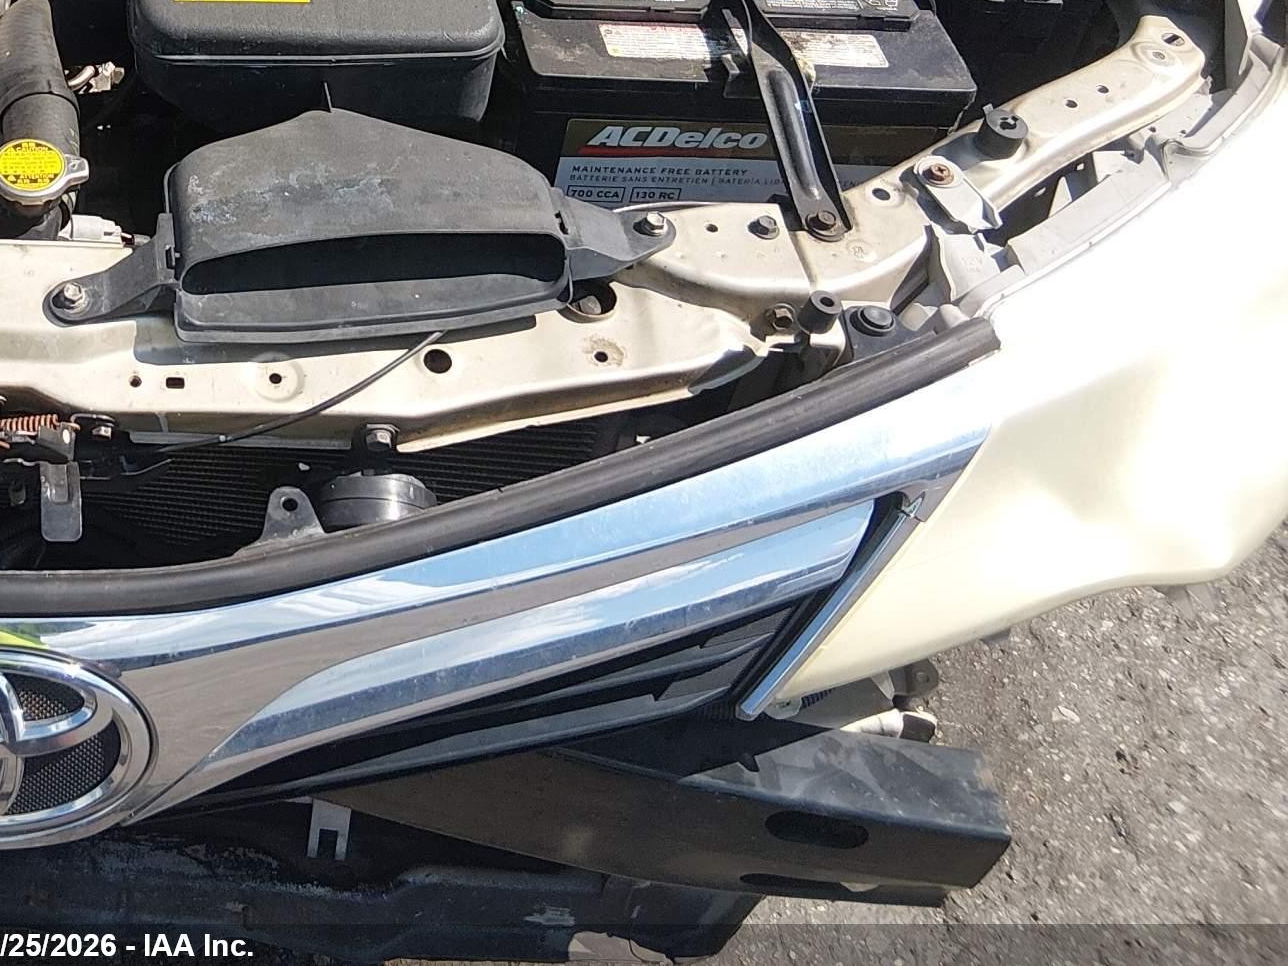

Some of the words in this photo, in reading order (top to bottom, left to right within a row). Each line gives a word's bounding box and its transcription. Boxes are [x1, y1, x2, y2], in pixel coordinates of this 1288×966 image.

[587, 126, 768, 150] ACDelco
[571, 165, 657, 175] MAINTENANCE
[660, 167, 692, 175] FREE
[694, 168, 749, 177] BATTERY
[569, 174, 618, 183] BATTERIE
[621, 175, 648, 183] SANS
[651, 176, 709, 185] ENTRETIEN
[570, 188, 593, 198] 700
[596, 190, 620, 199] CCA
[634, 190, 656, 199] 130
[658, 191, 675, 200] RC
